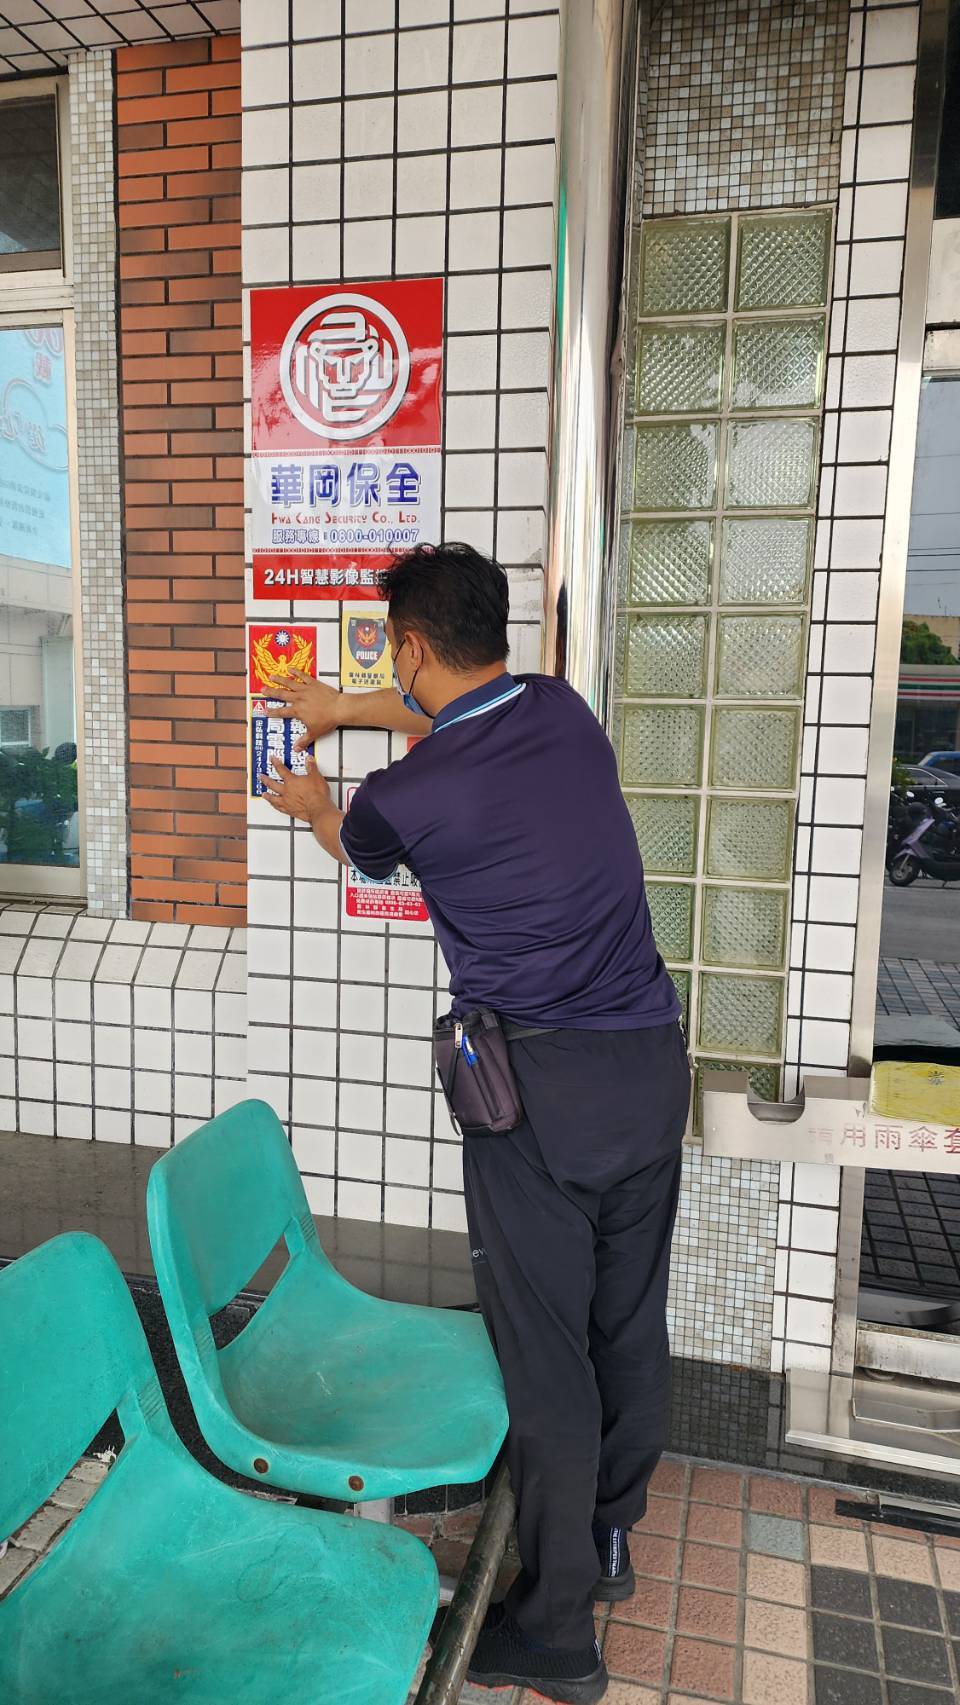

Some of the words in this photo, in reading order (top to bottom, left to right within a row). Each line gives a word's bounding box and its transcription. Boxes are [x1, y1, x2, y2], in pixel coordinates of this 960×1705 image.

[271, 463, 421, 507] 華岡保全
[356, 650, 378, 661] POLICE
